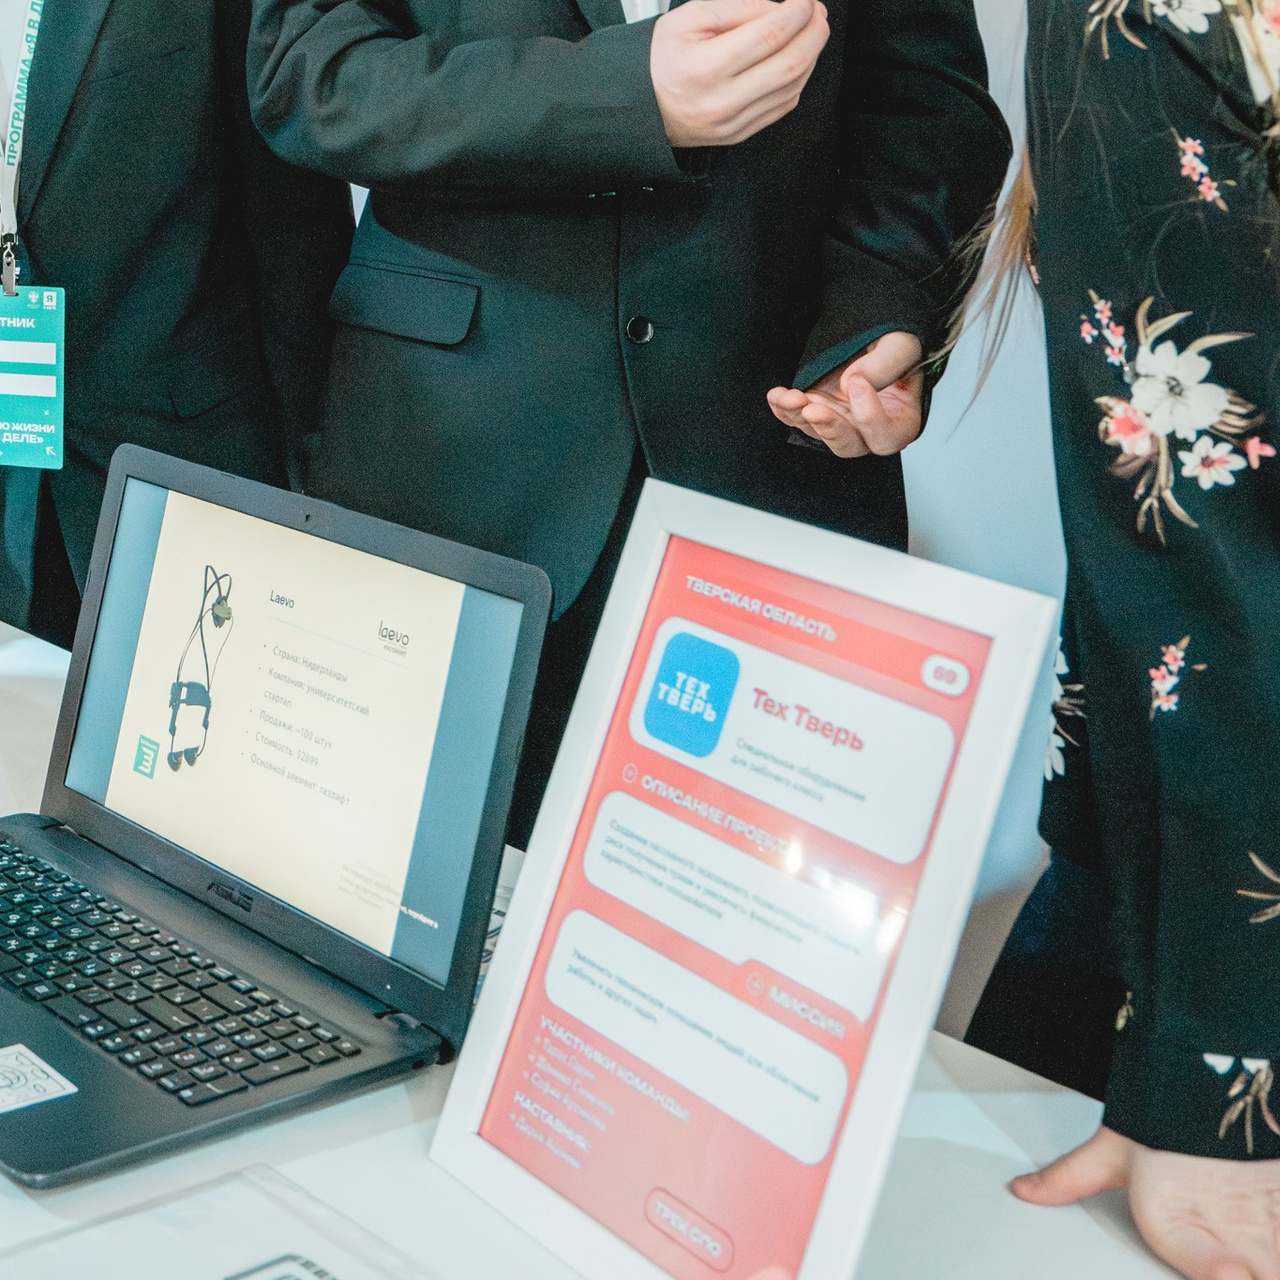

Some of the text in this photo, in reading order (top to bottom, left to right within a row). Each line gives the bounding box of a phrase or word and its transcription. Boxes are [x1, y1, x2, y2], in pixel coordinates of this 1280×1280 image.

[25, 33, 39, 54] «Я
[27, 18, 40, 31] В
[6, 58, 32, 166] ПРОГРАММА
[2, 433, 44, 444] ДЕЛЕ»
[11, 422, 55, 433] ЖИЗНИ
[270, 589, 295, 609] Laevo
[686, 575, 837, 641] ТВЕРСКАЯ ОБЛАСТЬ
[378, 620, 410, 646] laevo
[272, 645, 348, 683] Страна: Нидерланды
[263, 690, 292, 708] стартап
[268, 667, 370, 716] Компания: университетский
[658, 682, 717, 722] ТВЕРЬ
[675, 671, 711, 699] ТЕХ
[753, 688, 864, 751] Тех Тверь
[641, 775, 723, 824] ОПИСАНИЕ
[768, 986, 846, 1040] МИССИЯ
[541, 1015, 616, 1071] УЧАСТНИКИ
